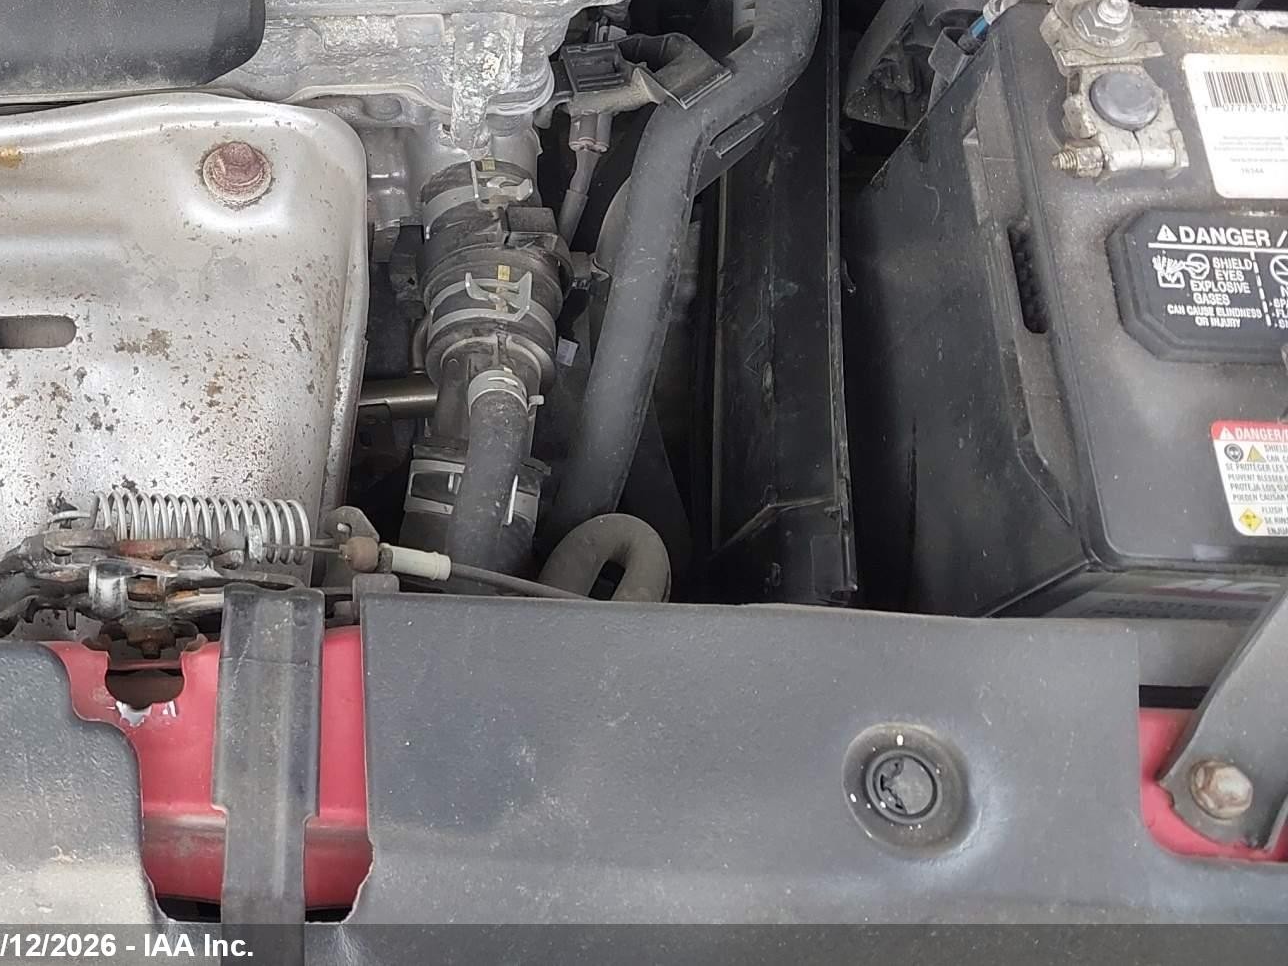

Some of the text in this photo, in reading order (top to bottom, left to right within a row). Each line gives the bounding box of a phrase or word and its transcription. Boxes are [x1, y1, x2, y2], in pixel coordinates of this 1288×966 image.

[1179, 225, 1271, 247] DANGER
[1212, 256, 1253, 271] SHIELD
[1214, 270, 1245, 282] EYES
[1190, 279, 1252, 294] EXPLOSIVE
[1193, 293, 1231, 306] GASES
[1167, 304, 1263, 319] CAN CAUSE BLINDNESS
[1195, 316, 1242, 328] OR INJURY
